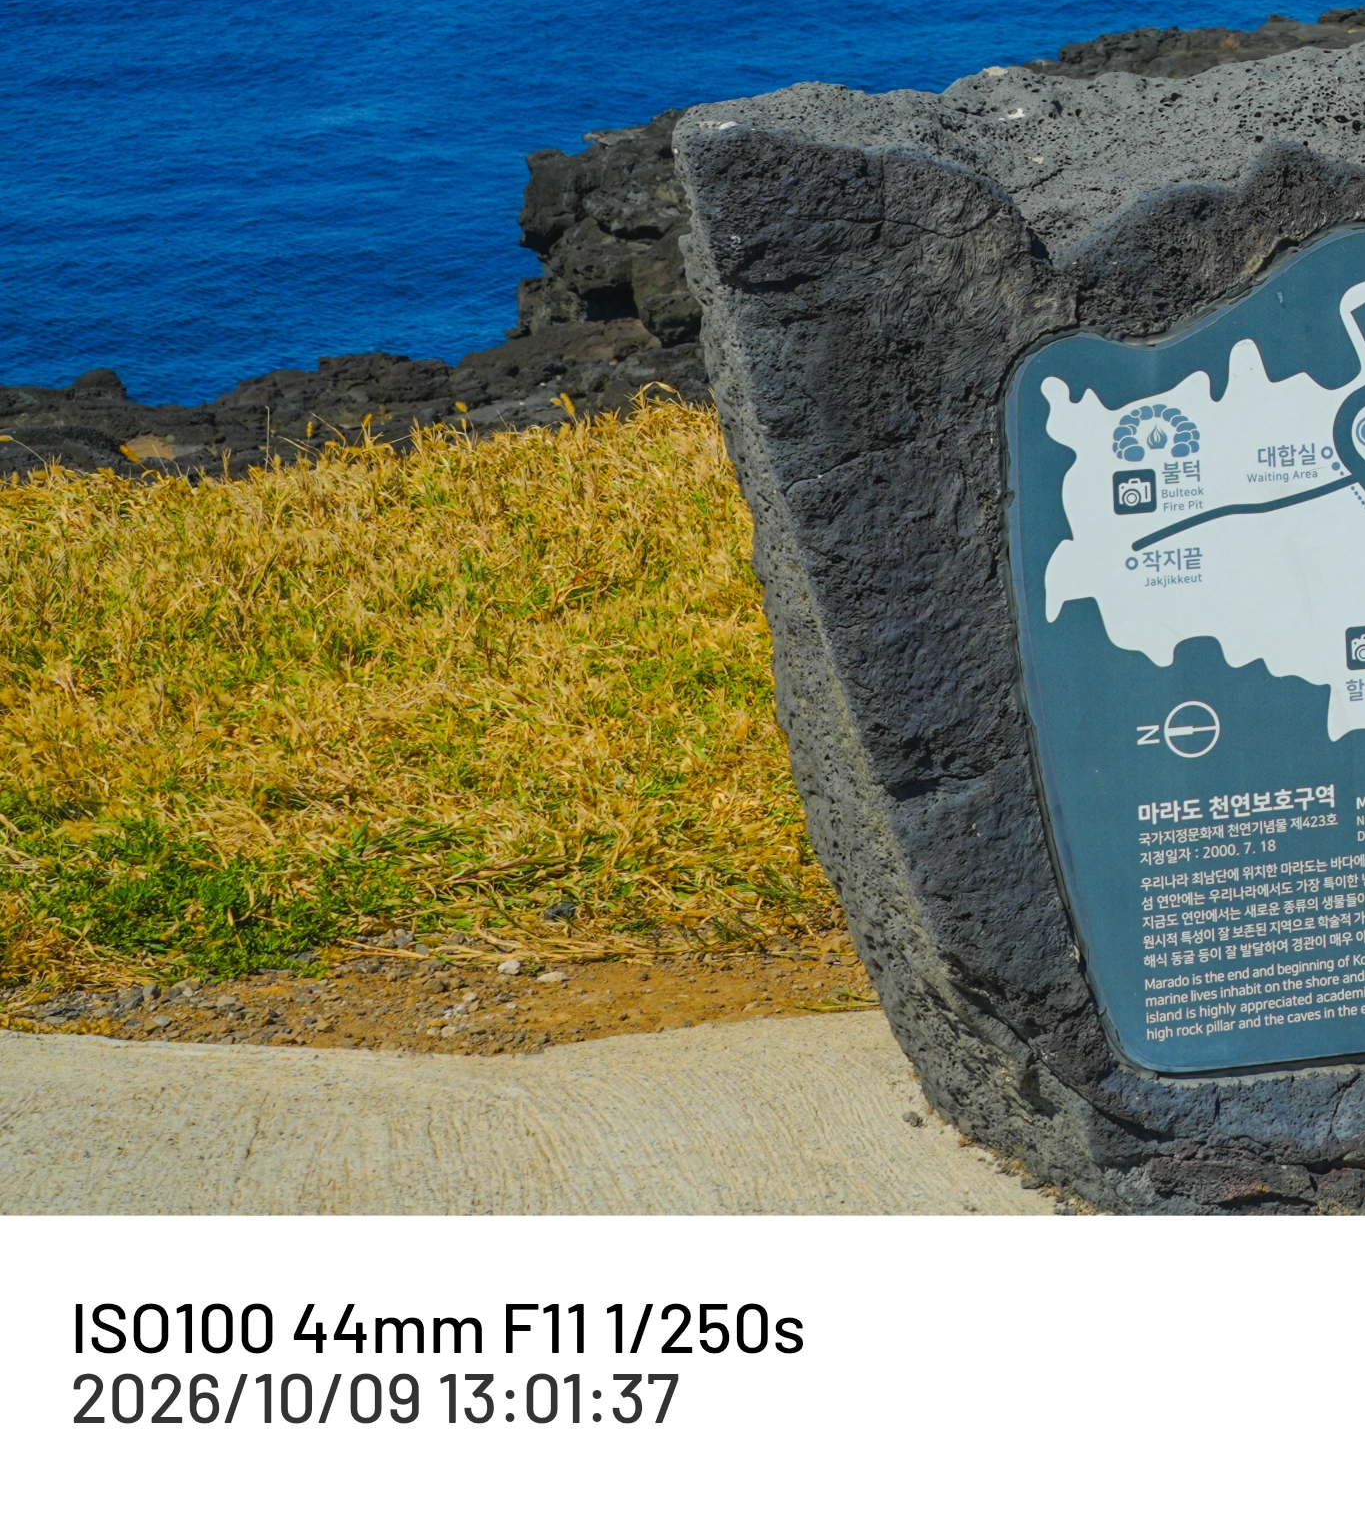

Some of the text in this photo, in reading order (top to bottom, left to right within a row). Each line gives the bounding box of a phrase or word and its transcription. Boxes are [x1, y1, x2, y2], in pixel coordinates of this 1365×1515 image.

[1257, 443, 1316, 468] 대합실
[1162, 459, 1200, 484] 불턱
[1246, 470, 1318, 483] Waiting Area
[1161, 486, 1204, 499] Bulteok
[1163, 499, 1203, 512] Fire Pit
[1142, 547, 1203, 572] 작지끝
[1144, 573, 1202, 588] Jakjikkeut
[1138, 784, 1335, 825] 마라도 천연보호구역
[1138, 813, 1338, 846] 국가지정문화재 천연기념물 제423호
[1139, 847, 1192, 866] 지정일자
[1203, 843, 1240, 859] 2000.
[1243, 841, 1256, 854] 7.
[1260, 839, 1276, 852] 18
[1140, 873, 1189, 891] 우리나라
[1191, 867, 1239, 885] 최남단에
[1242, 863, 1278, 880] 위치한
[1280, 859, 1328, 876] 마라도는
